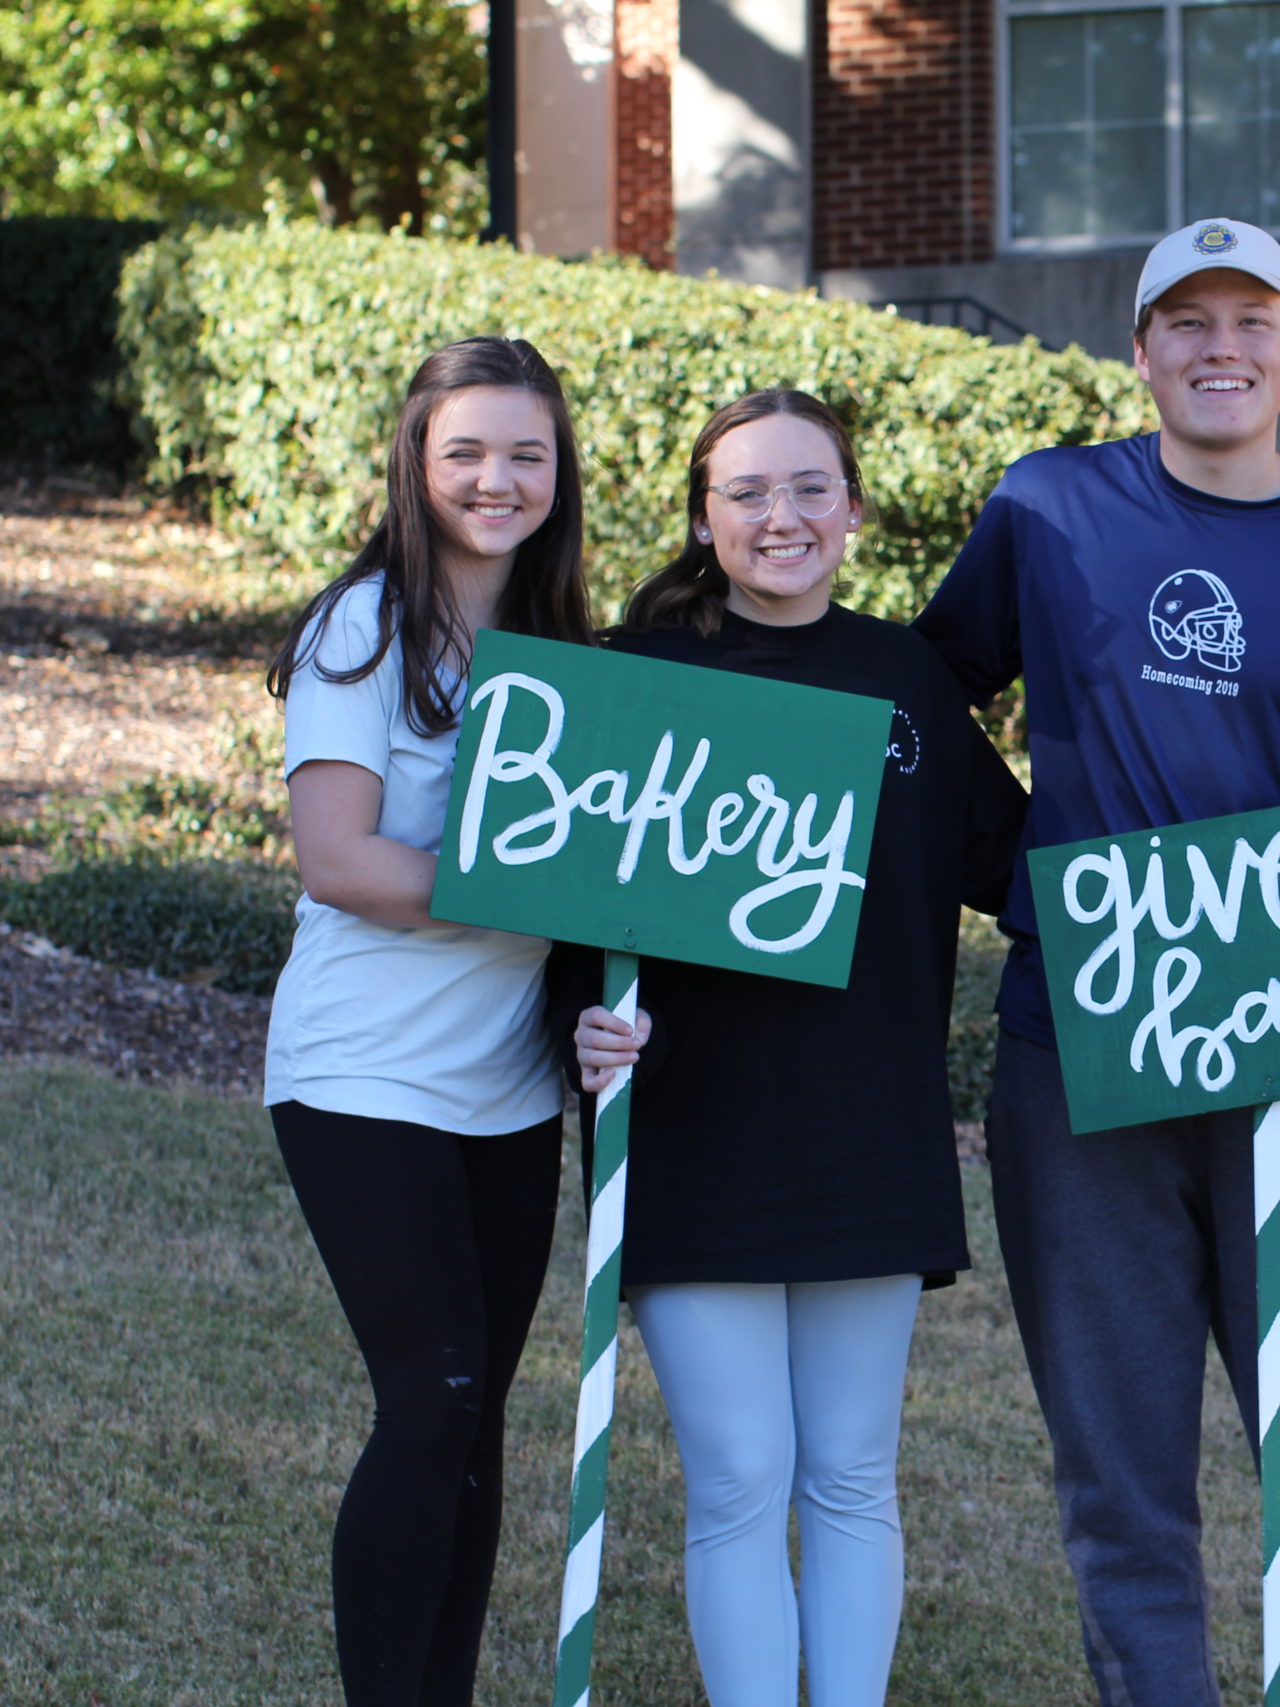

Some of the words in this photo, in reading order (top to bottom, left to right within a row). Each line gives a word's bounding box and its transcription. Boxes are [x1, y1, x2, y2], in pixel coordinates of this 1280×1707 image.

[1141, 664, 1213, 695] Homecoming
[1215, 679, 1239, 697] 2019
[458, 672, 865, 953] Bakery
